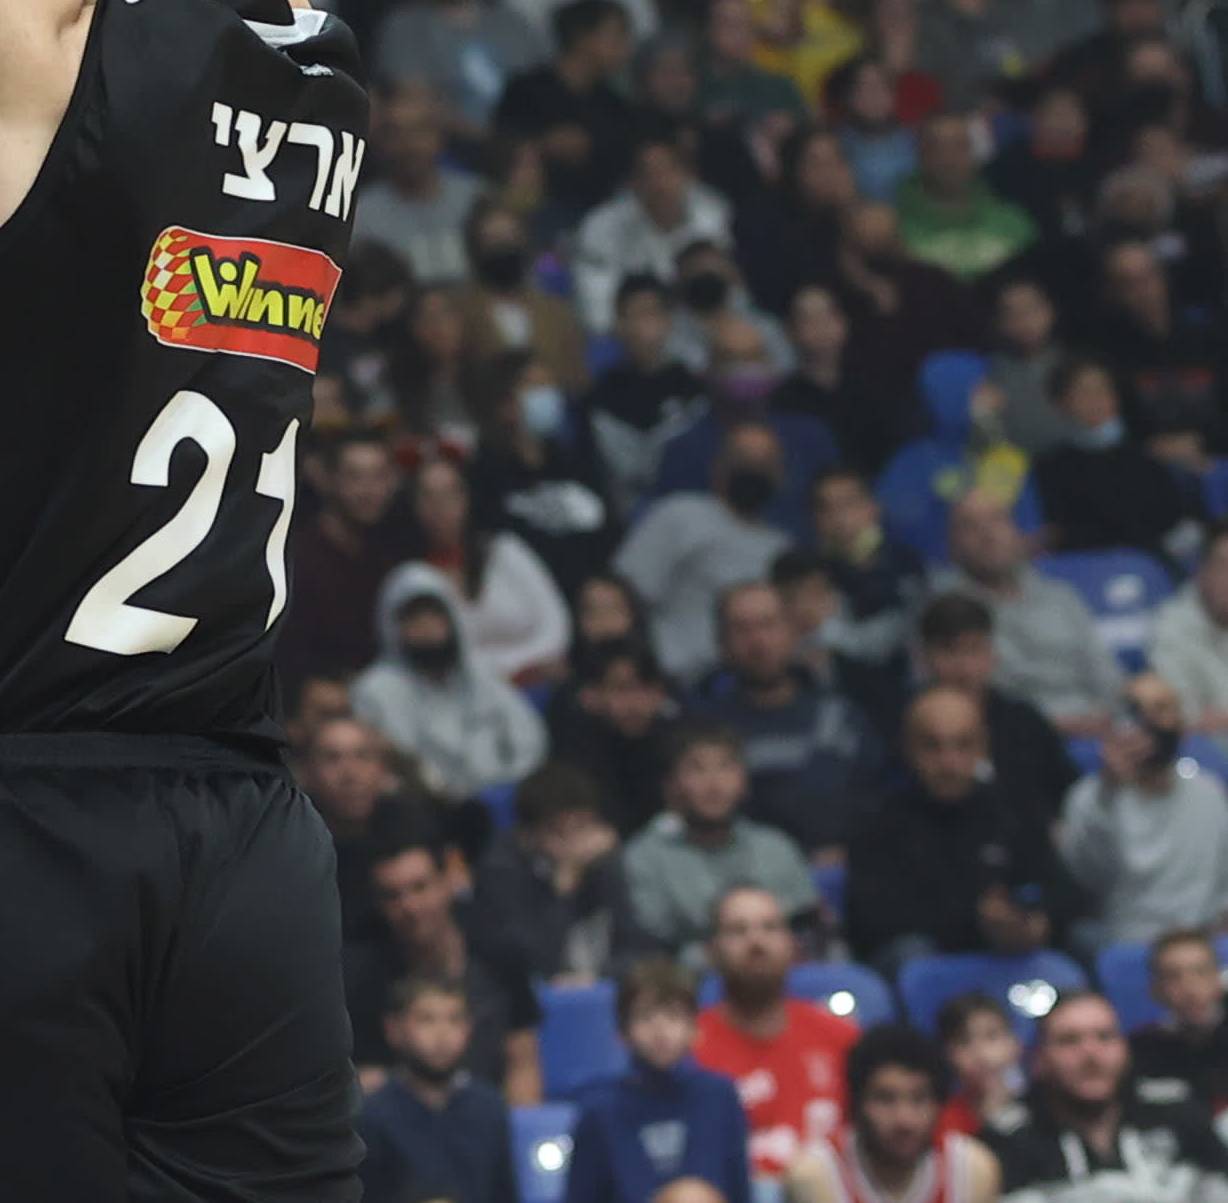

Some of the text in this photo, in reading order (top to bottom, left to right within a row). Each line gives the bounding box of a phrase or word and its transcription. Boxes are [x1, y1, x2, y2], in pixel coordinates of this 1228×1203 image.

[211, 101, 365, 222] ארצי
[190, 252, 325, 341] Winne
[63, 389, 300, 656] 21
